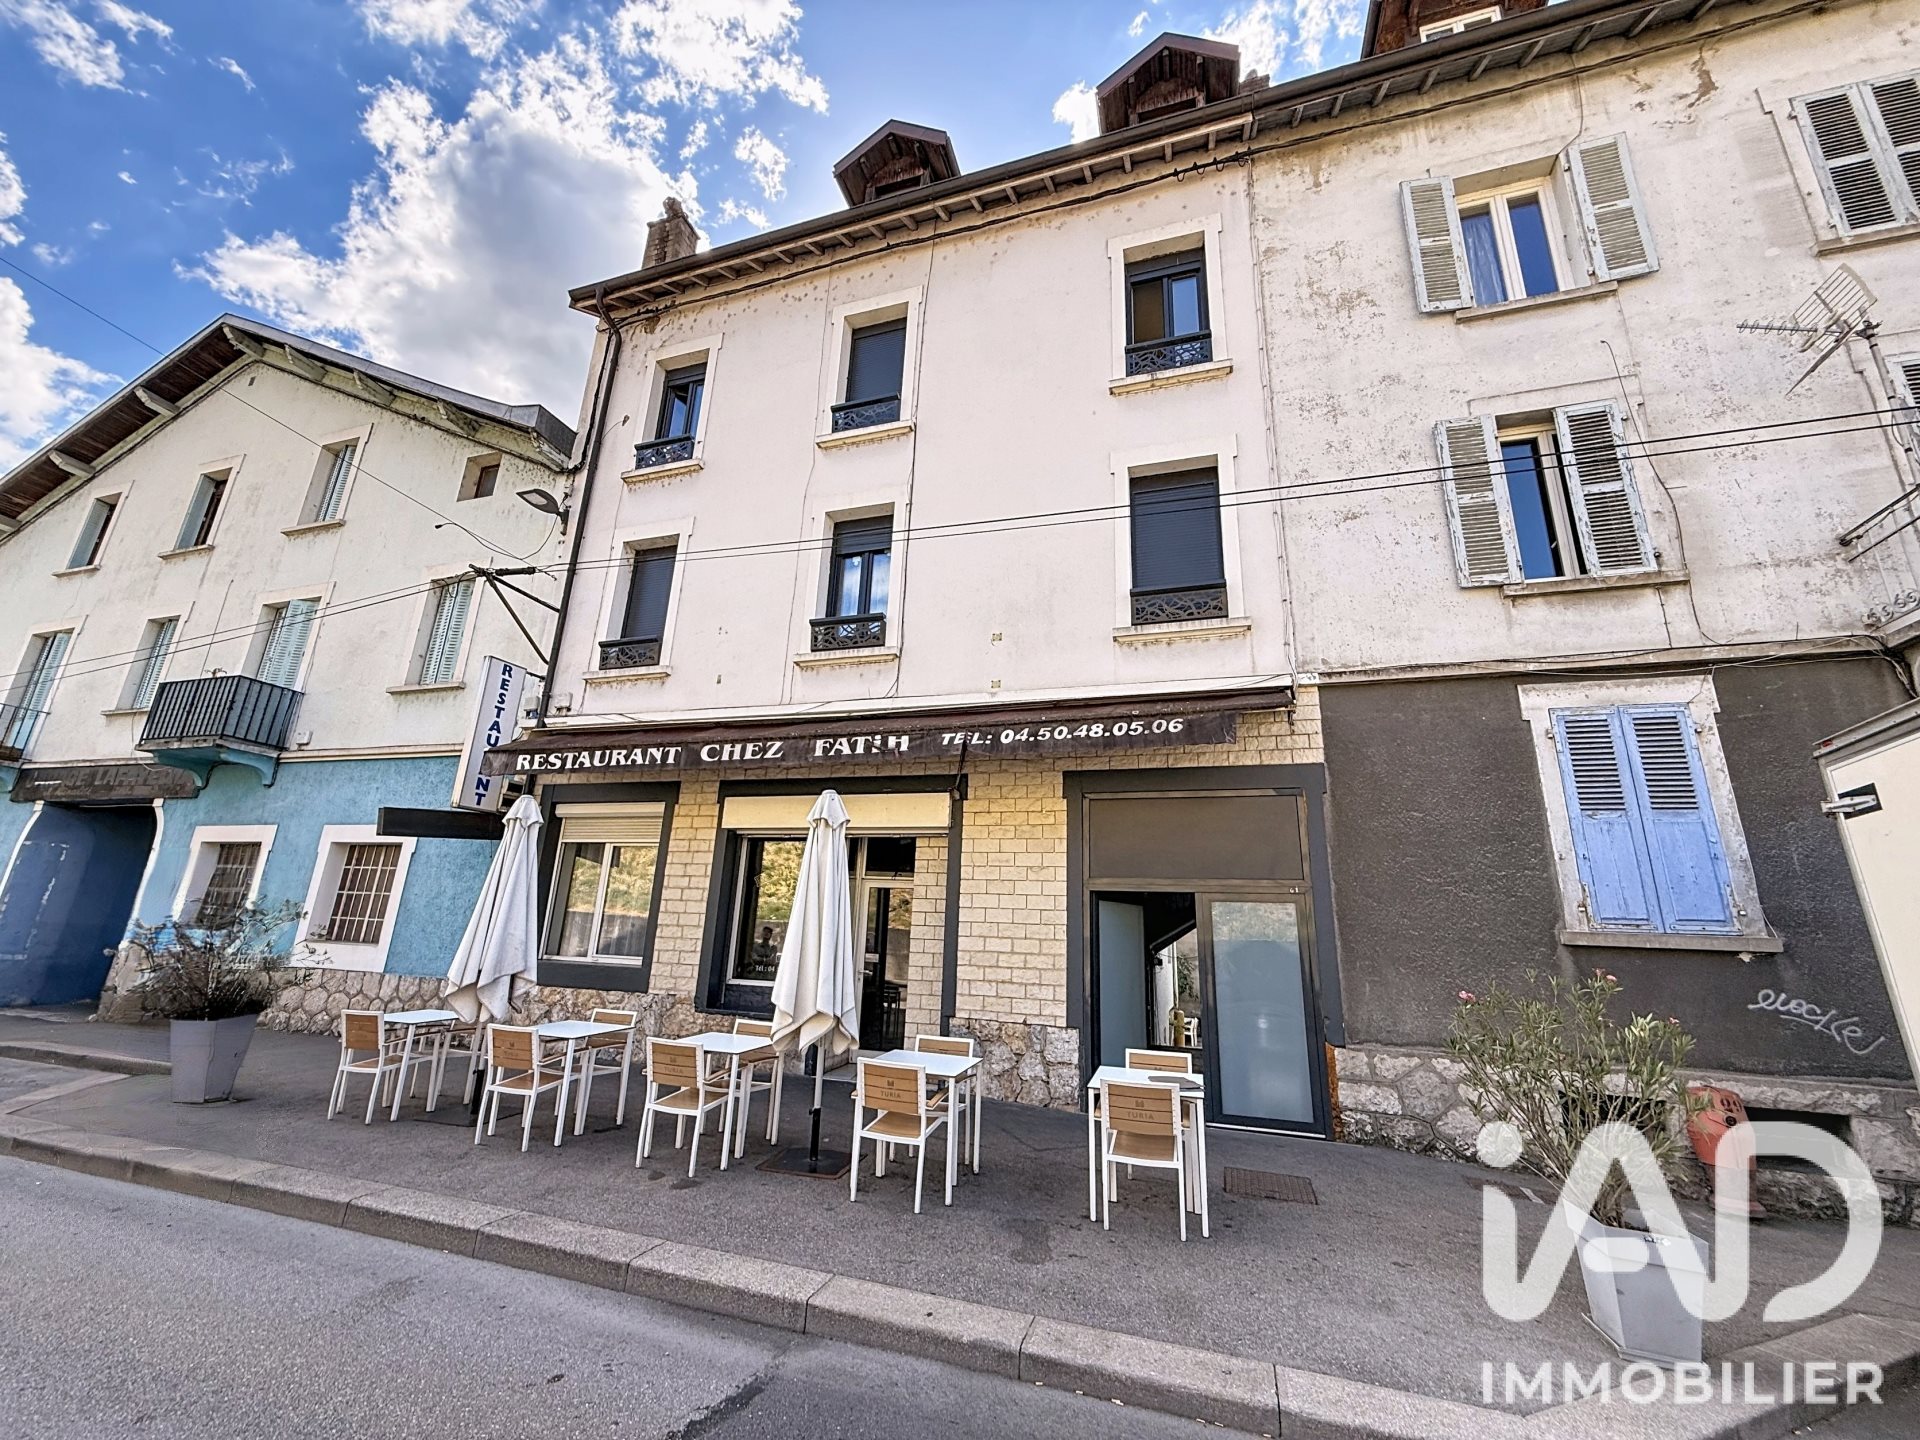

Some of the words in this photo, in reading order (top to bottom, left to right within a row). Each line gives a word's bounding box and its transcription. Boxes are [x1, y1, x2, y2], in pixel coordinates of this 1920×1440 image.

[475, 663, 513, 806] RESTAUNT
[1000, 718, 1184, 744] 04.50.48.05.06
[516, 747, 681, 770] RESTAURANT
[700, 741, 784, 762] CHEZ
[880, 1090, 902, 1099] TURIA
[1127, 1111, 1155, 1121] TURIA
